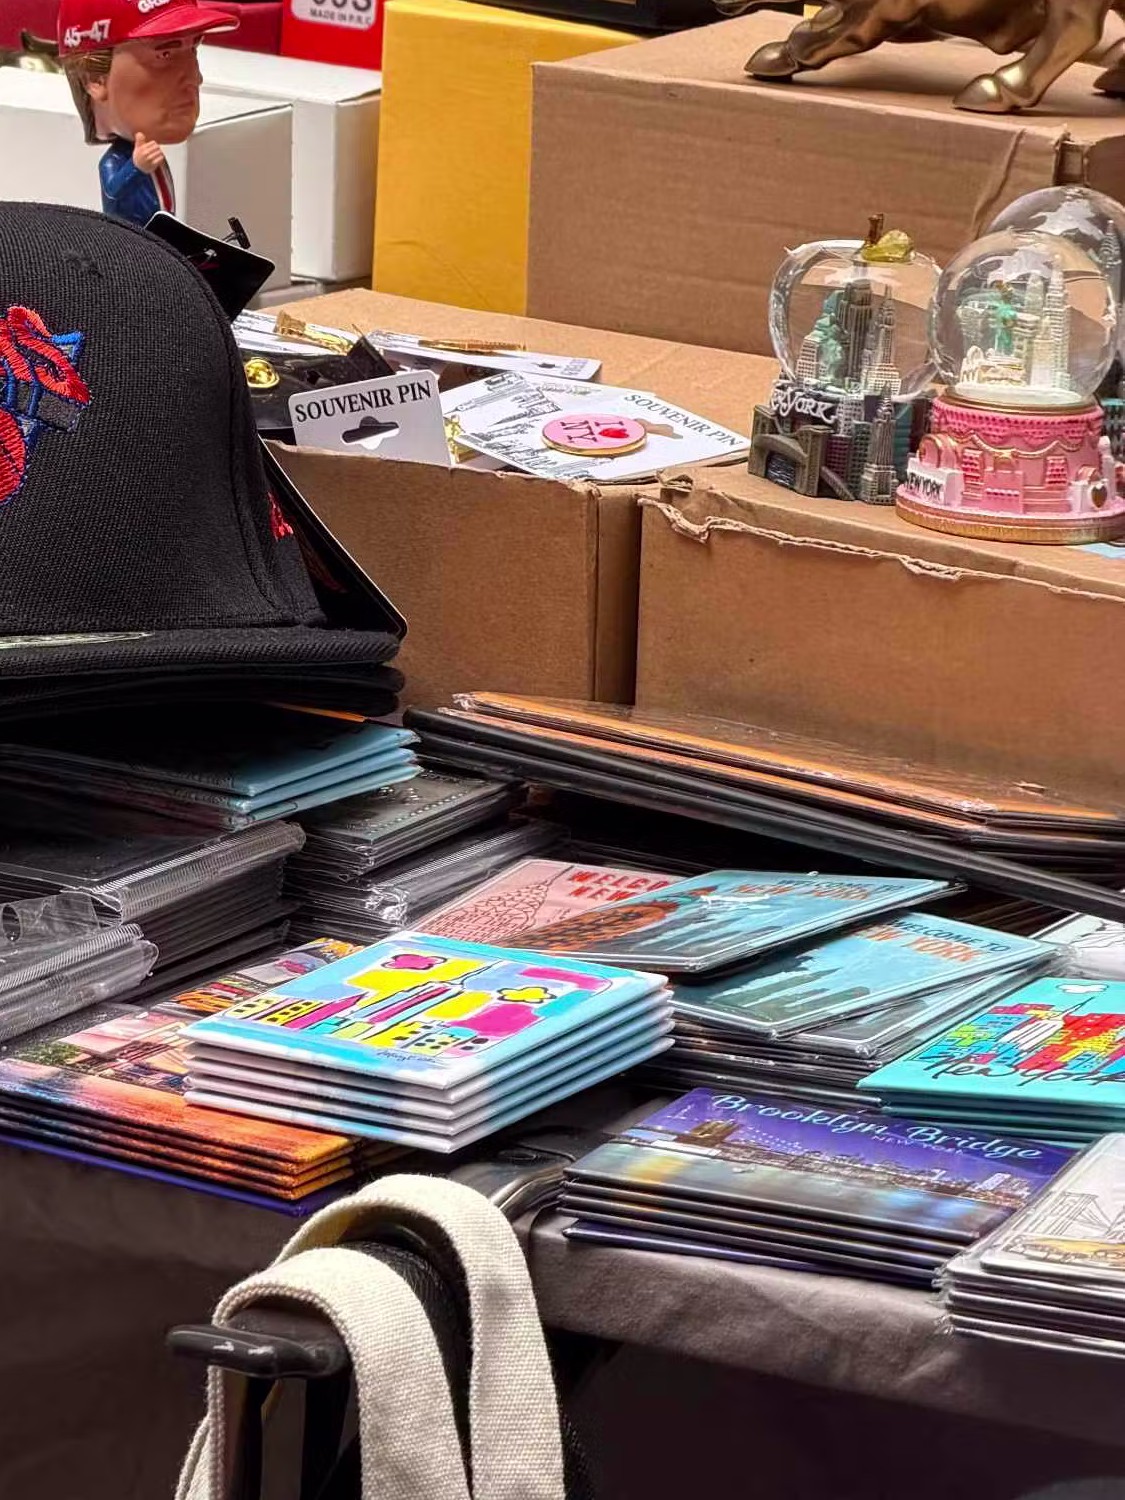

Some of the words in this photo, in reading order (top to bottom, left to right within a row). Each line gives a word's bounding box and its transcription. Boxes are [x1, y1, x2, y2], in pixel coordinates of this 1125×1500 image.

[310, 7, 335, 21] MADE
[337, 11, 347, 22] IN
[294, 387, 395, 422] SOUVENIR
[398, 380, 432, 405] PIN
[623, 394, 711, 434] SOUVENIR
[707, 428, 743, 447] PIN
[923, 478, 943, 500] YORK
[569, 870, 670, 891] WELCO
[569, 886, 637, 902] NEW
[892, 918, 983, 946] WELCOME
[983, 941, 1012, 953] TO
[903, 934, 983, 962] YORK
[711, 1094, 887, 1134] Brooklyn
[906, 1126, 1045, 1159] Bridge
